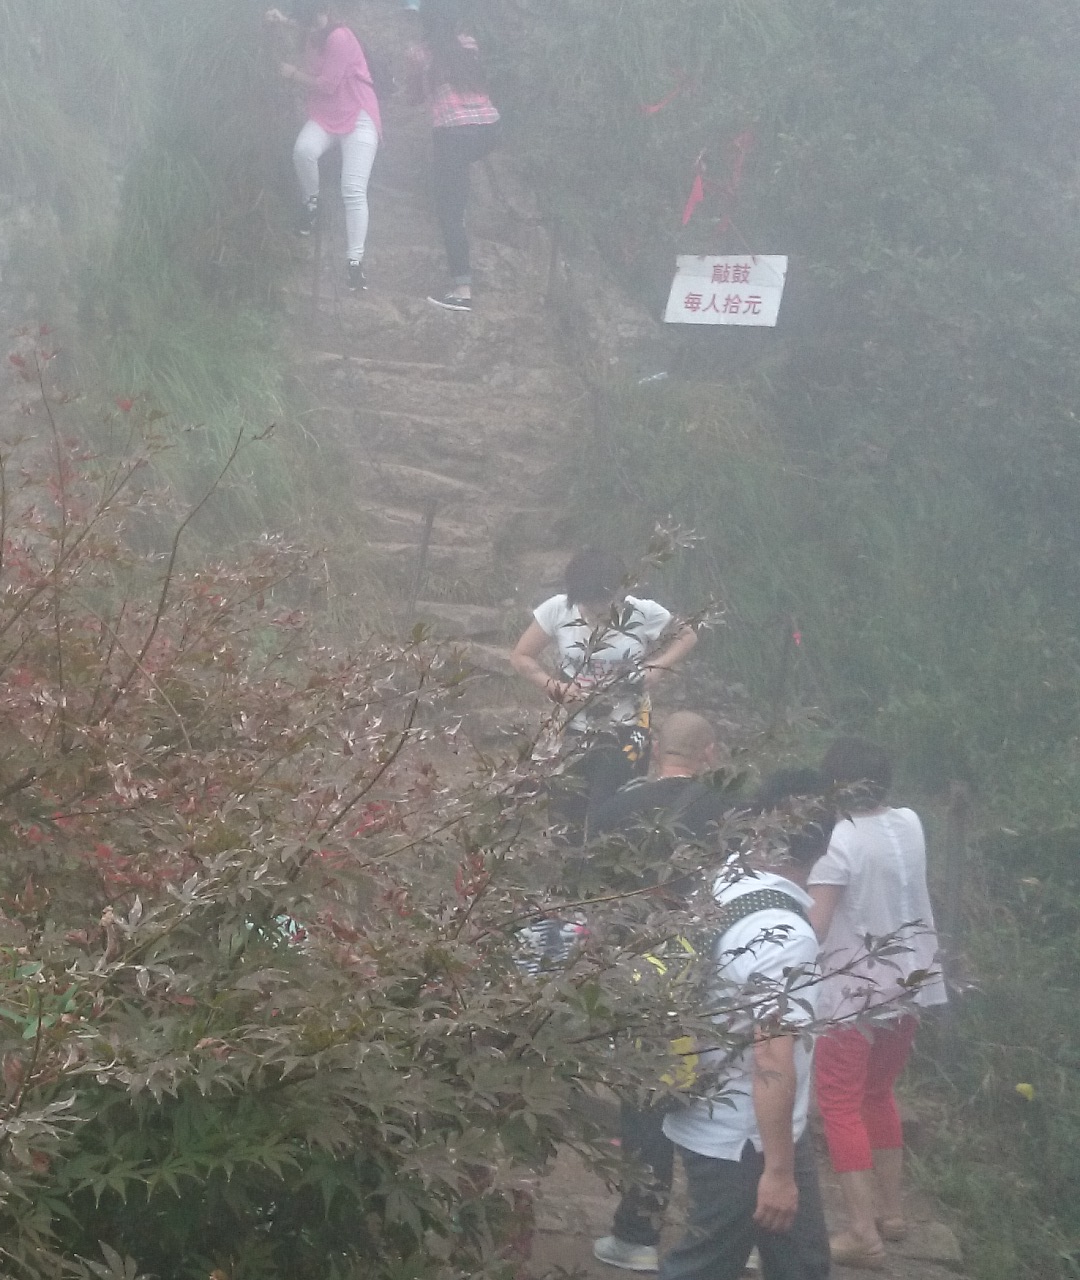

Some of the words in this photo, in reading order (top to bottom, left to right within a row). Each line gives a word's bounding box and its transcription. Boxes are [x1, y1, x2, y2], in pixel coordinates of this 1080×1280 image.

[711, 263, 751, 284] 敲鼓
[684, 292, 762, 315] 每人拾元
